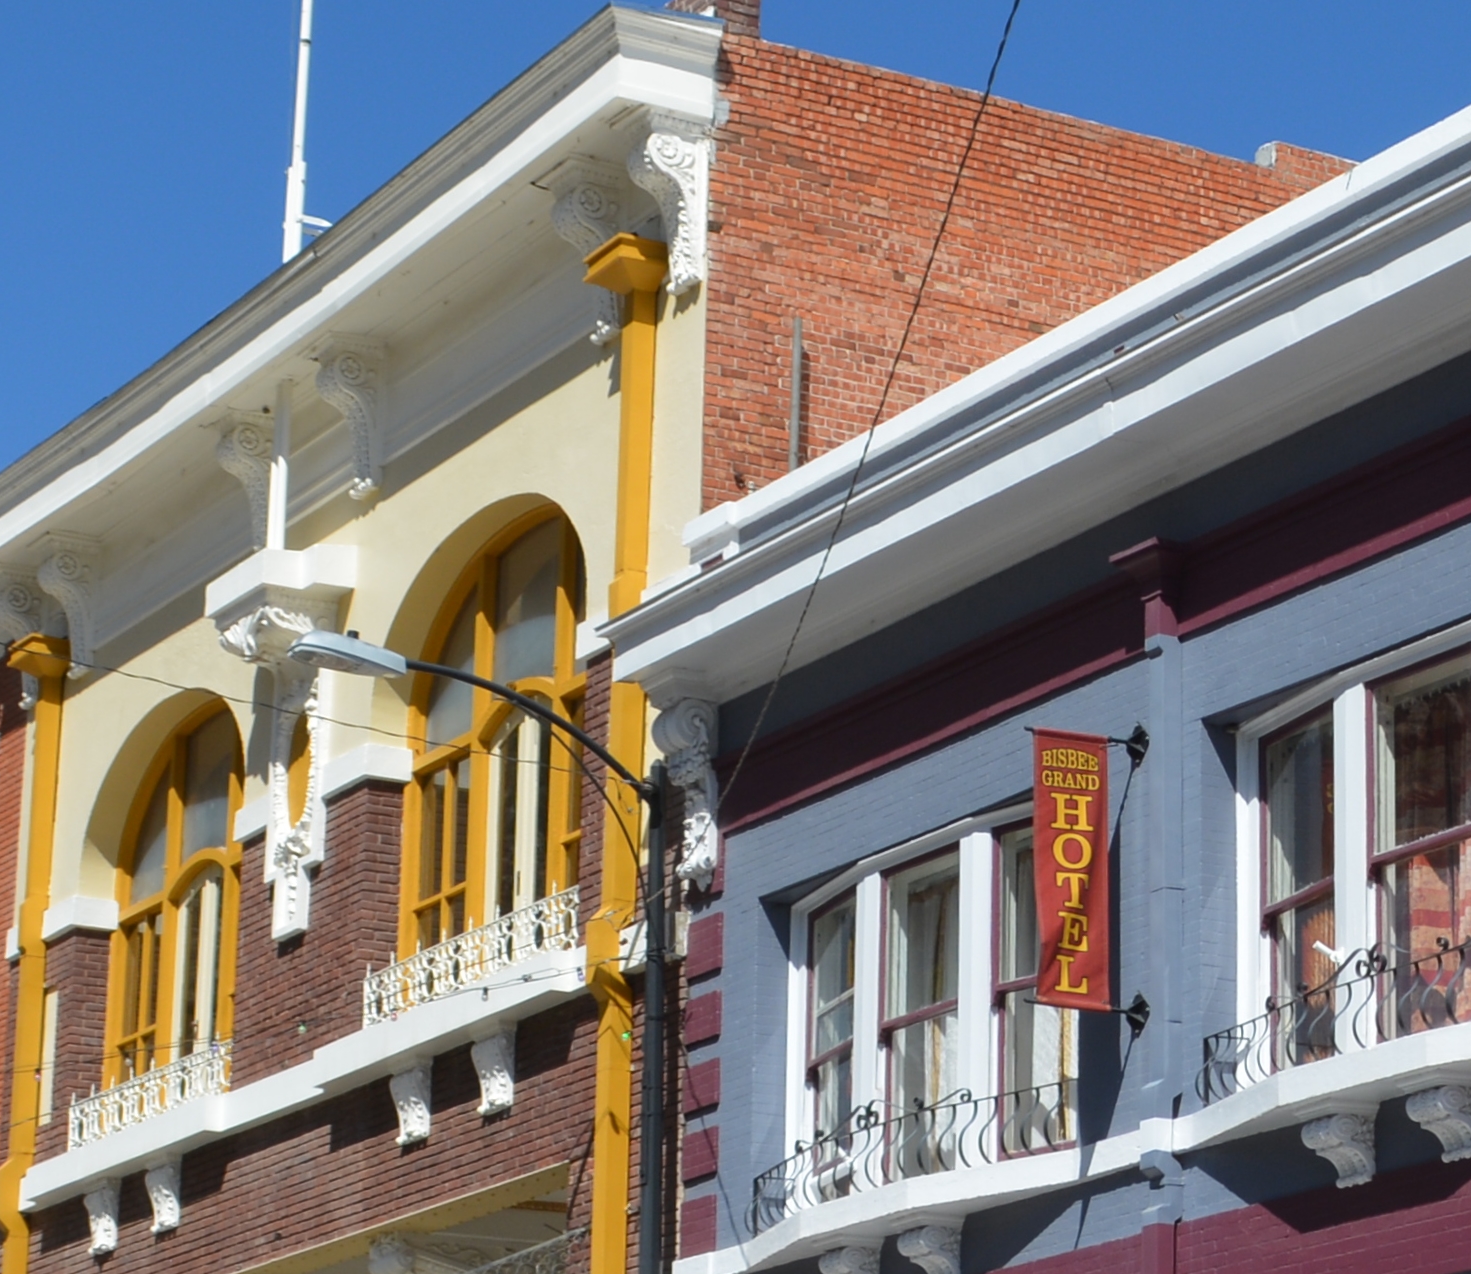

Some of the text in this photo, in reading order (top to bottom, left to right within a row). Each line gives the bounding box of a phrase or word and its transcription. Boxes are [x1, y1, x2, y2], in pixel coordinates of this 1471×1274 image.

[1041, 748, 1099, 772] BISBEE
[1041, 770, 1100, 791] GRAND
[1050, 792, 1094, 995] HOTEL
